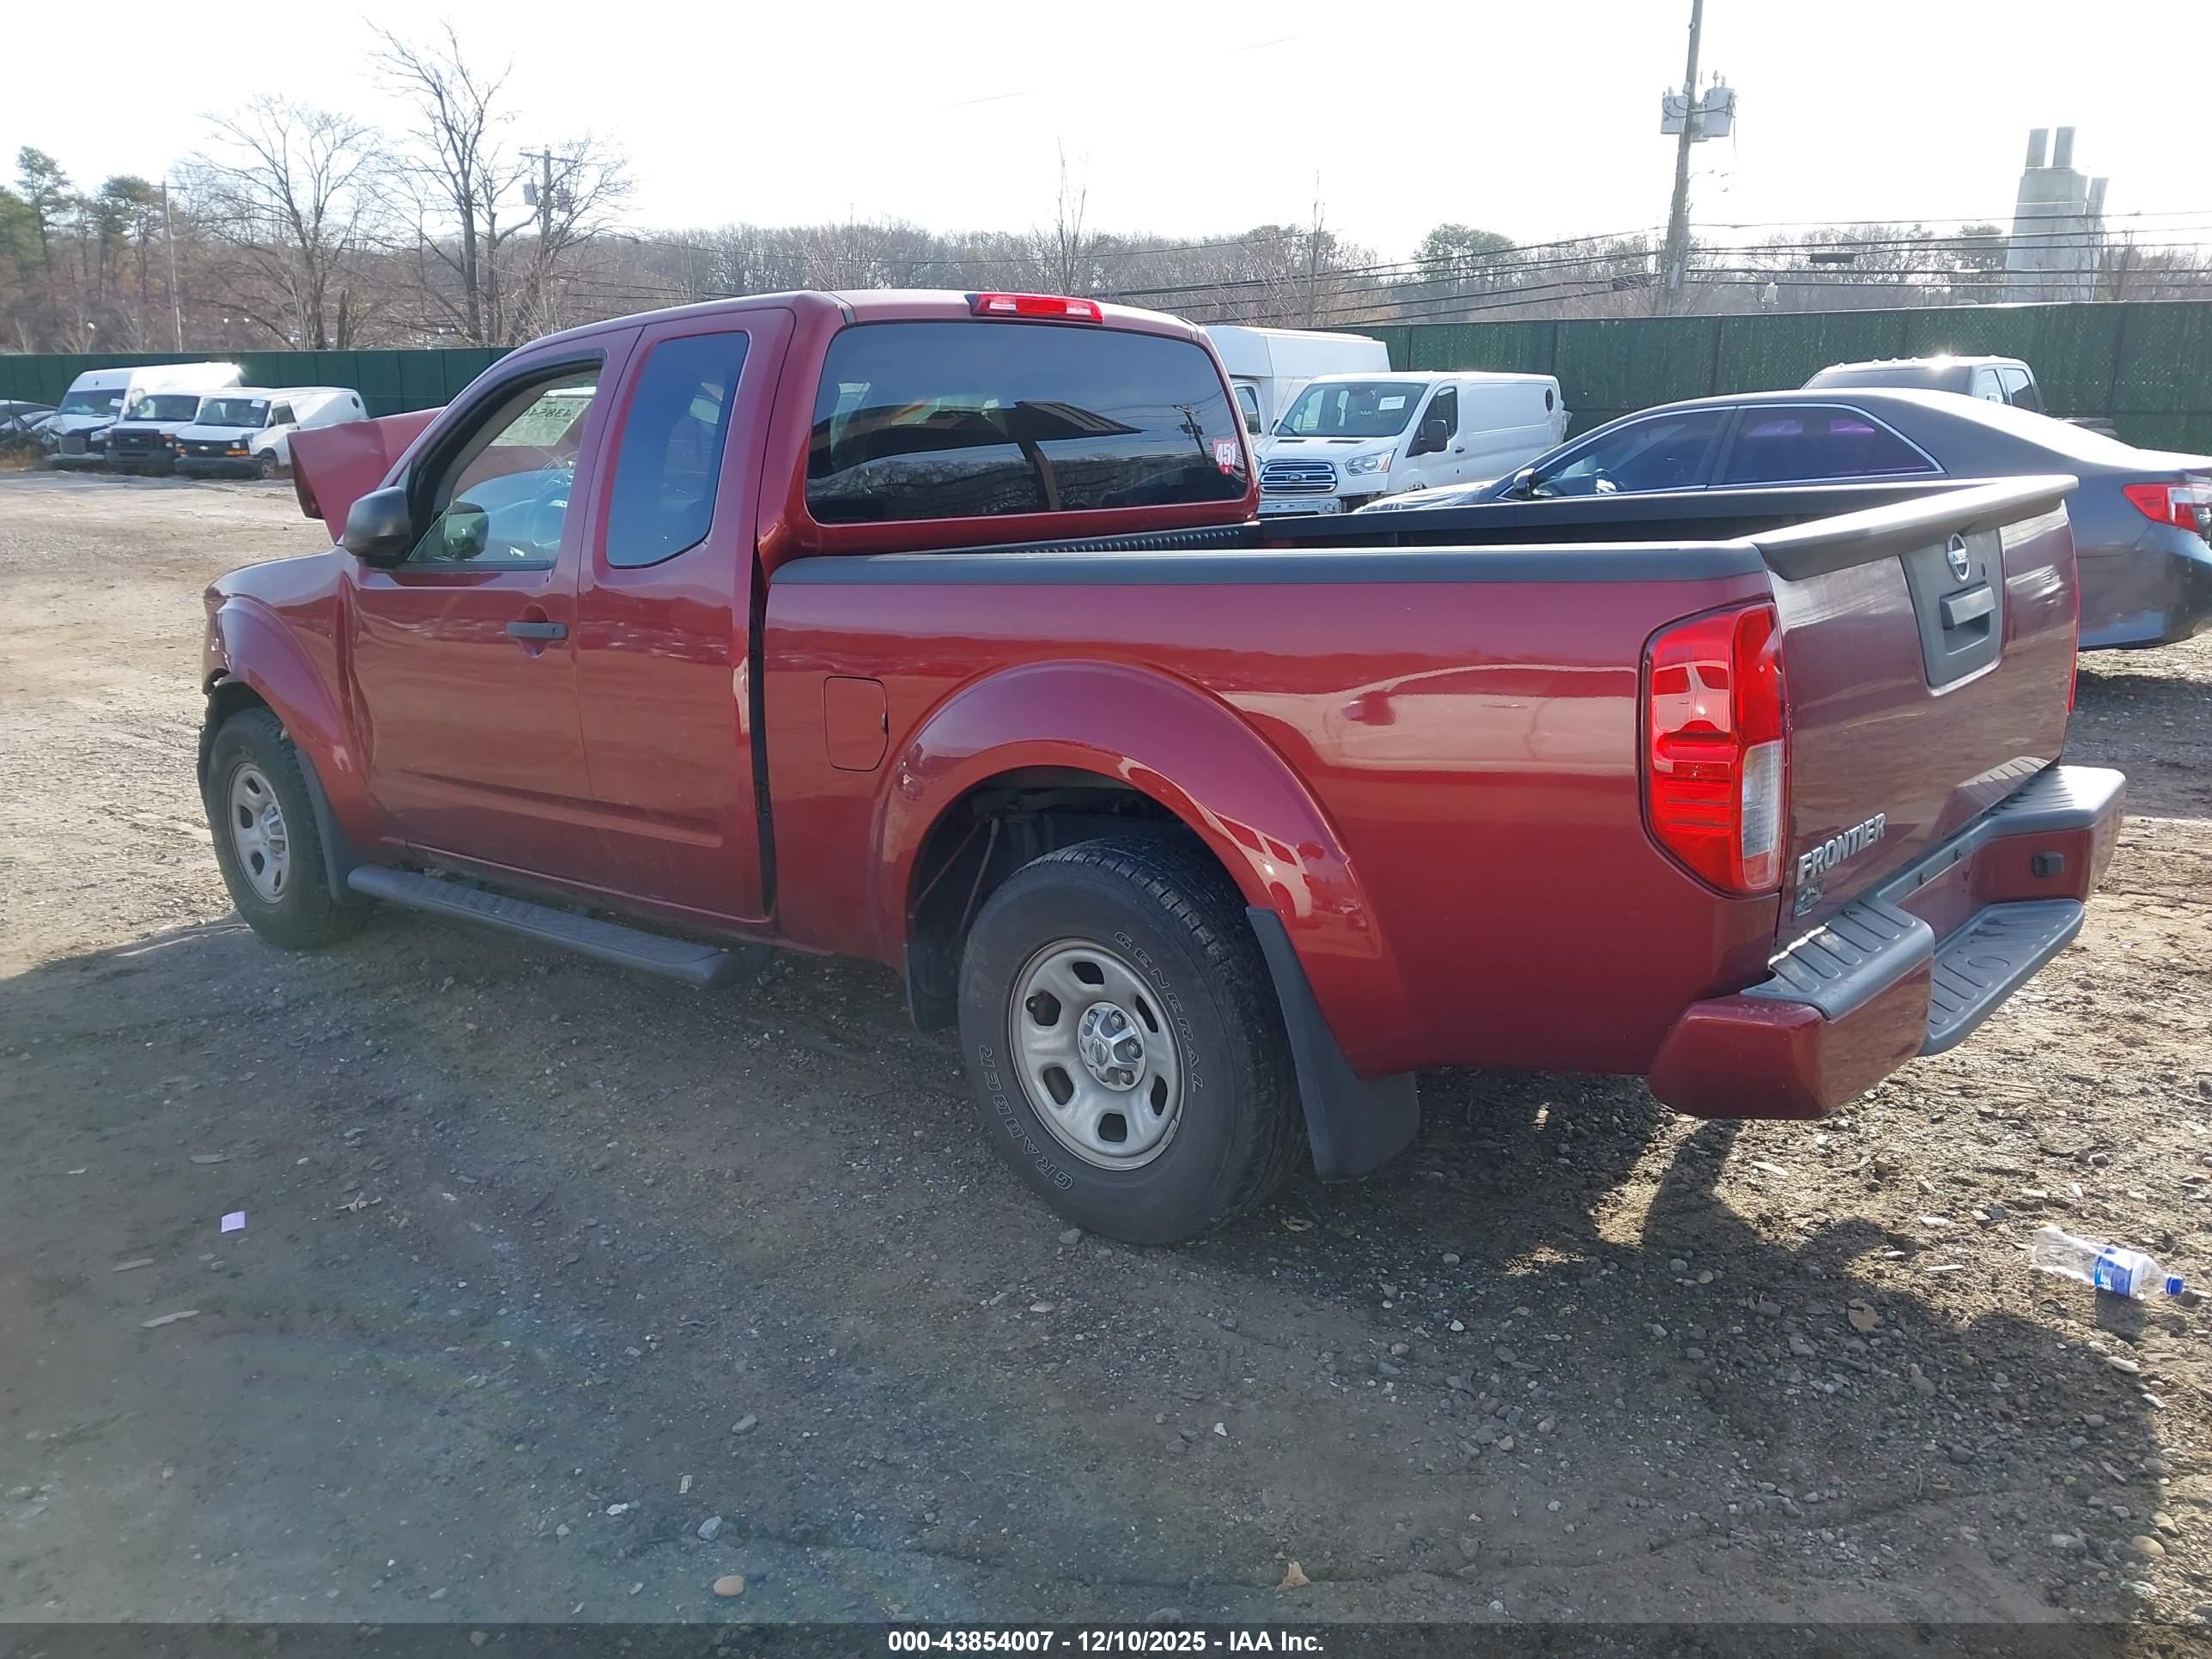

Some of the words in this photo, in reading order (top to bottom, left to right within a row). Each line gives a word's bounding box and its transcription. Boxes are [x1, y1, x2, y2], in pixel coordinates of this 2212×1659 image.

[1215, 443, 1237, 466] 451
[1796, 812, 1887, 885] FRONTIER
[1115, 931, 1203, 1092] GENERAL
[979, 1044, 1073, 1189] GRABBER
